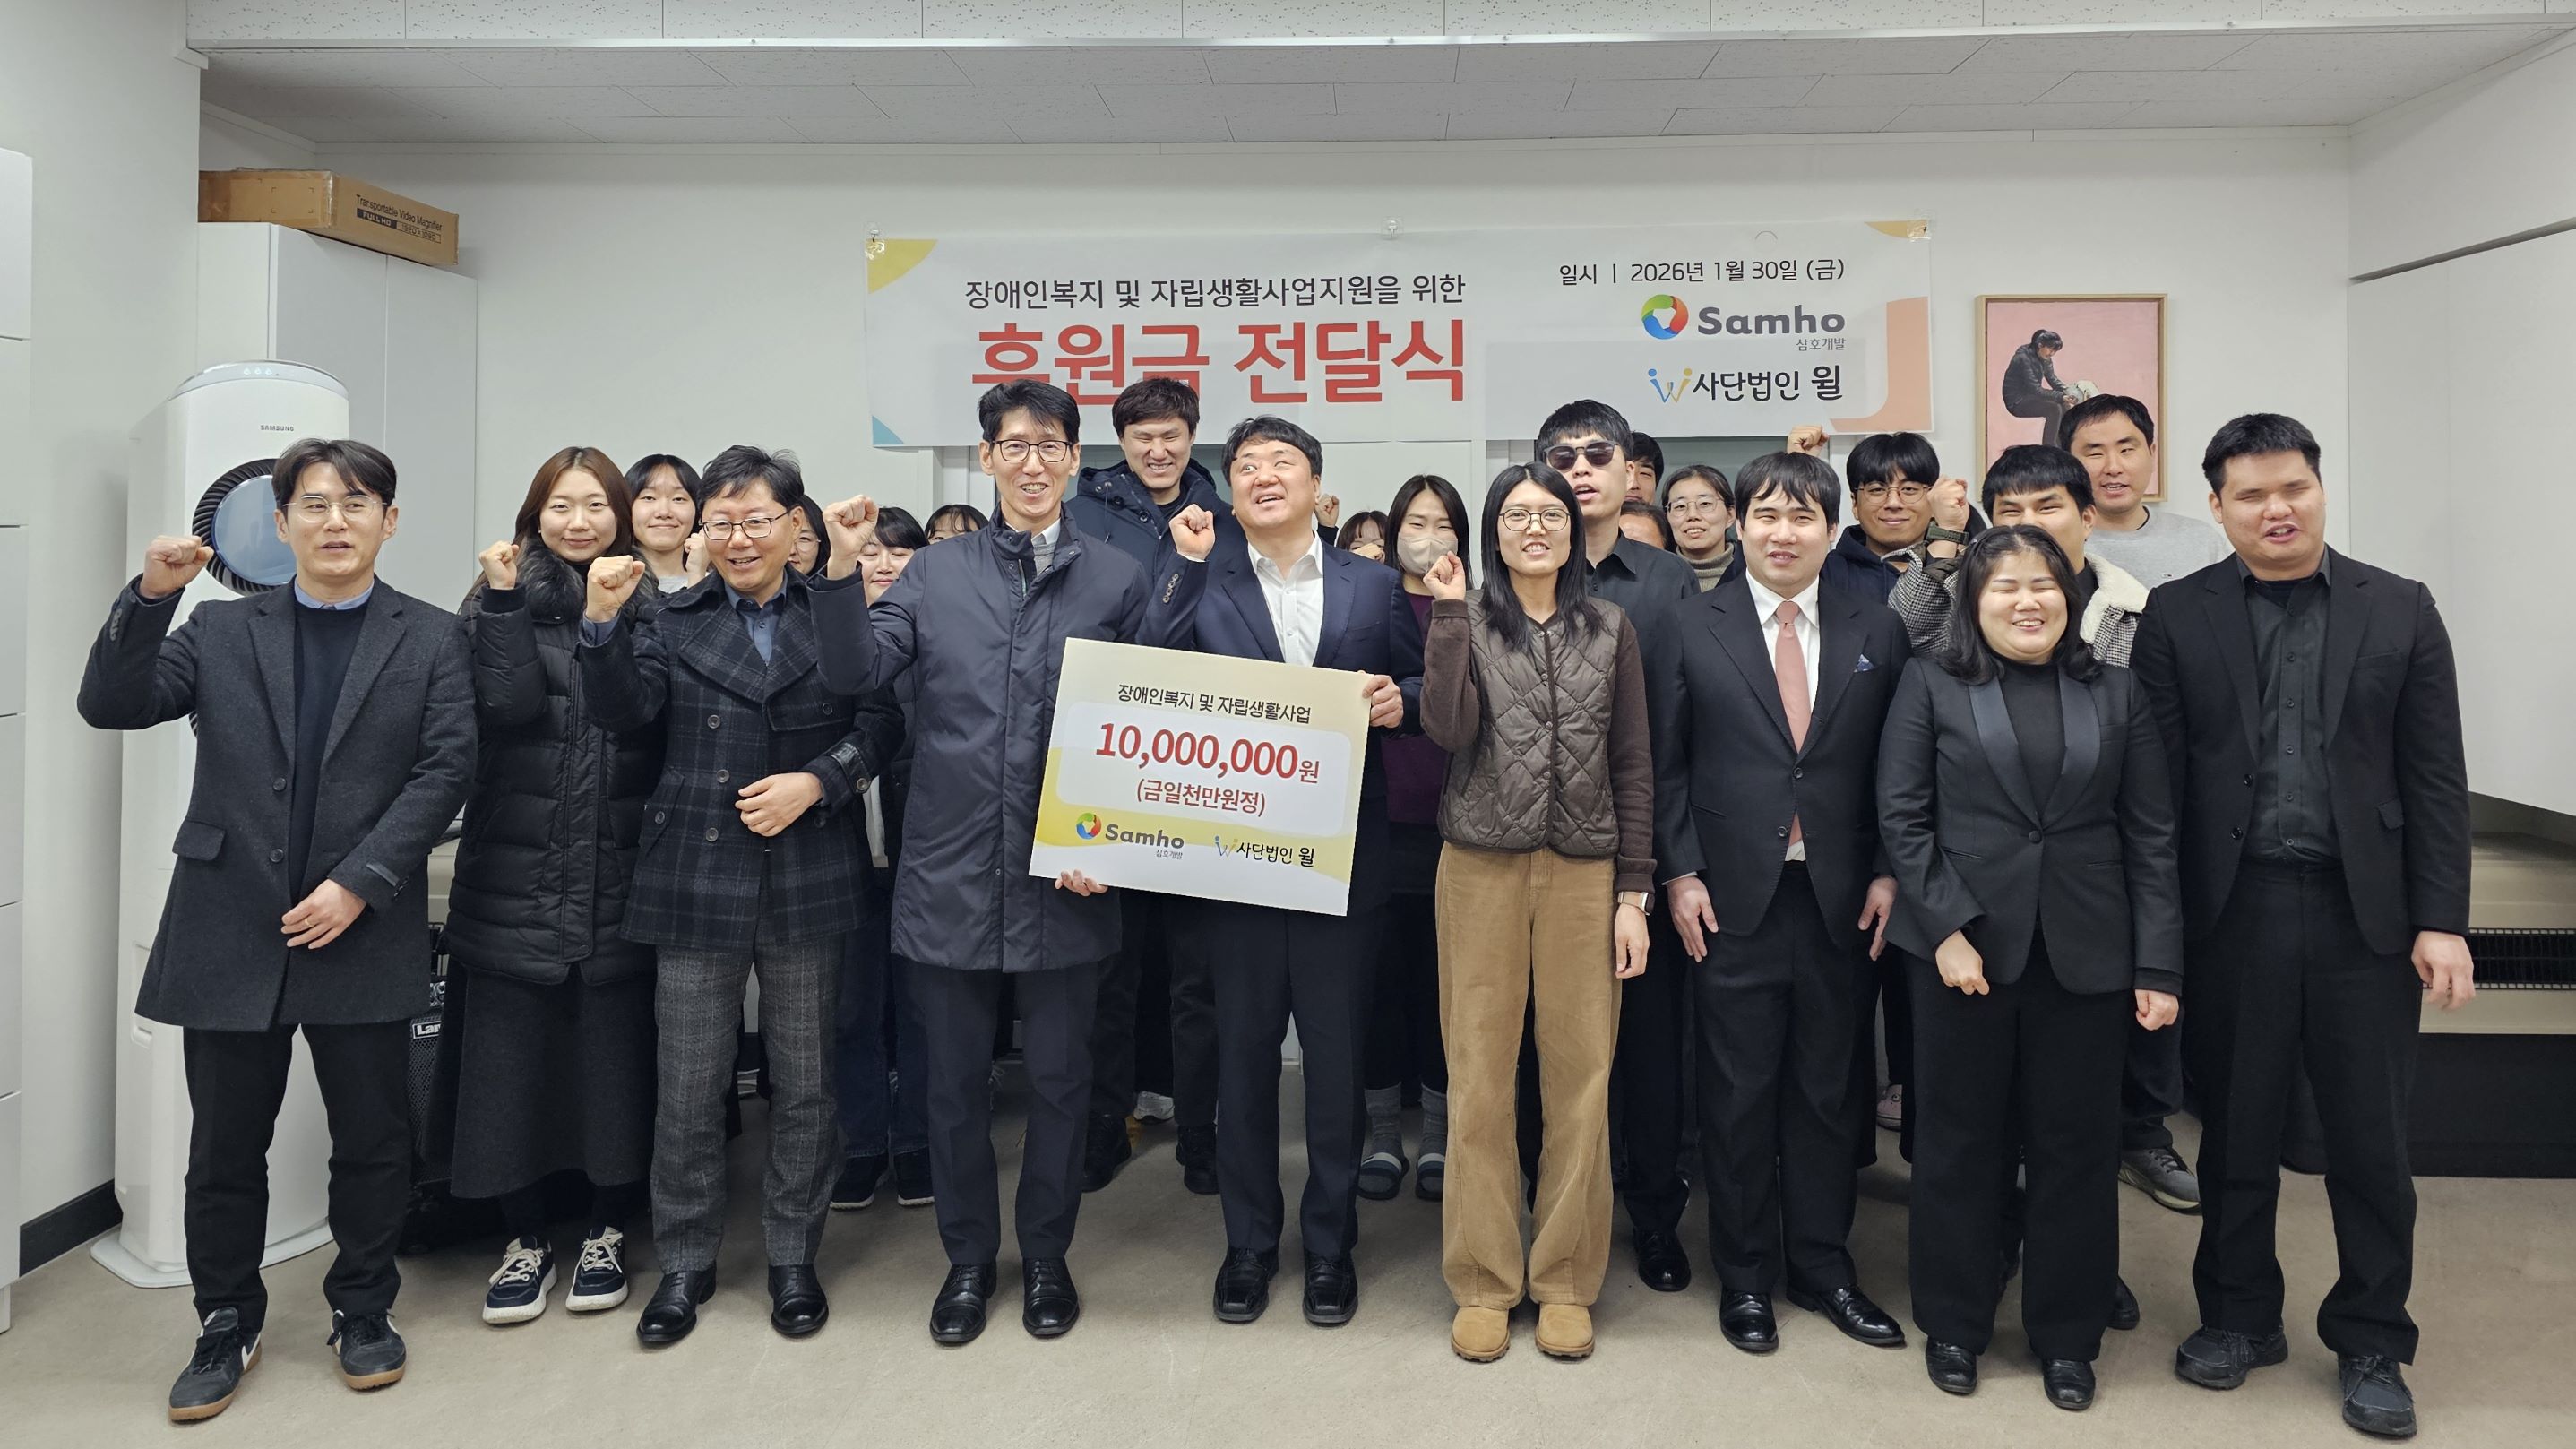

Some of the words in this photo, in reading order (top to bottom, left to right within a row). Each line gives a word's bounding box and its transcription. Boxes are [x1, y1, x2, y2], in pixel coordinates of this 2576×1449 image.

[362, 211, 380, 222] FULL
[381, 217, 392, 227] HD
[399, 208, 416, 223] Video
[416, 215, 443, 230] Magnifier
[1558, 263, 1598, 286] 일시
[1630, 261, 1704, 283] 2026년
[1714, 260, 1745, 282] 1월
[1752, 259, 1797, 281] 30일
[1806, 258, 1845, 280] (금)
[964, 280, 1104, 309] 장애인복지
[1116, 279, 1141, 308] 및
[1150, 275, 1402, 307] 자립생활사업지원을
[1411, 274, 1466, 306] 위한
[1697, 304, 1846, 335] Samho
[1796, 337, 1846, 352] 삼호개발
[971, 323, 1210, 406] 후원금
[1234, 319, 1464, 403] 전달식
[1692, 370, 1800, 402] 사단법인
[1117, 683, 1194, 711] 장애인복지
[1199, 694, 1214, 712] 및
[1217, 695, 1311, 724] 자립생활사업
[1096, 722, 1320, 784] 10,000,000원
[1136, 778, 1266, 817] (금일천만원정)
[1105, 824, 1185, 850] Samho
[1236, 842, 1293, 865] 사단법인
